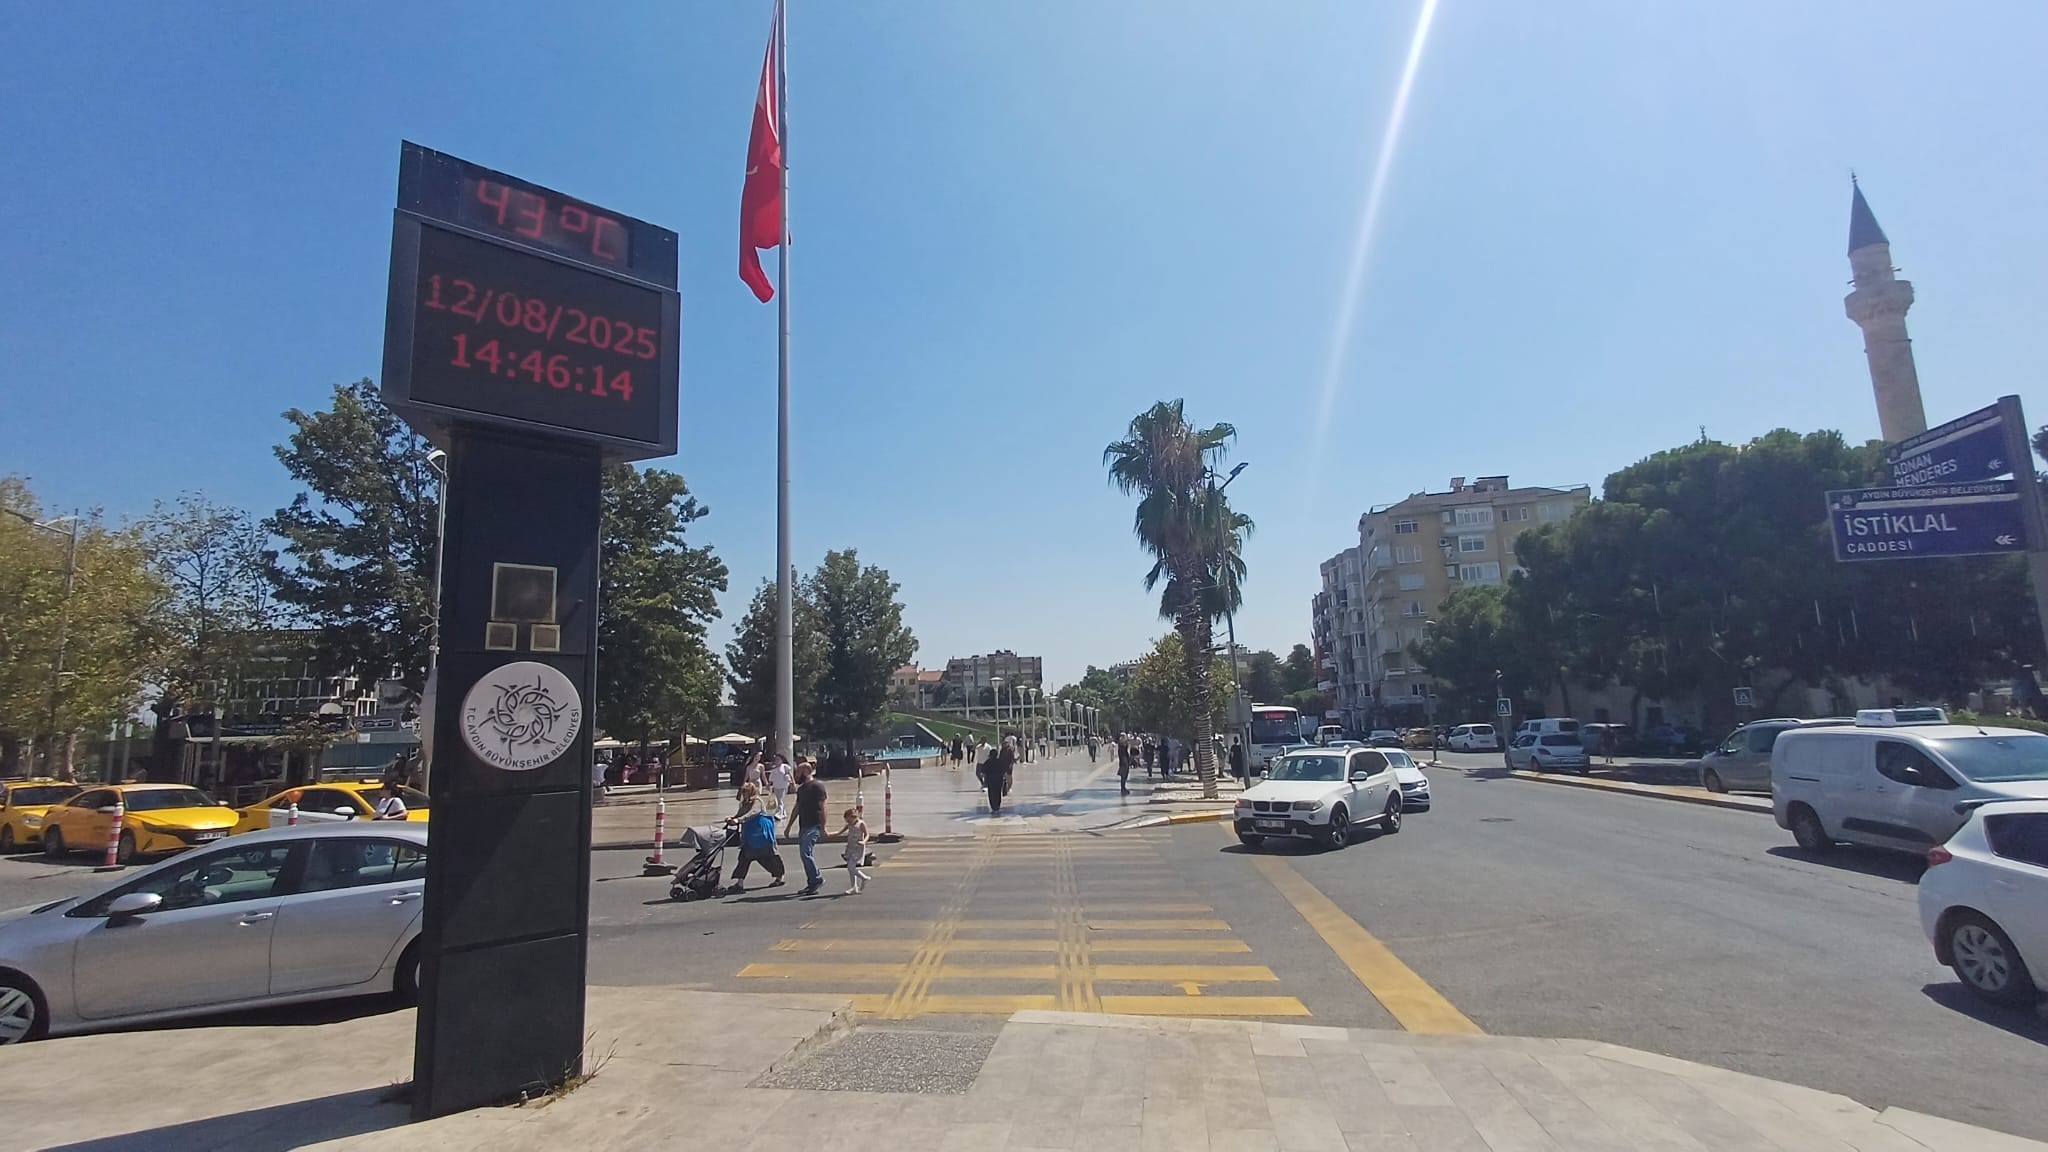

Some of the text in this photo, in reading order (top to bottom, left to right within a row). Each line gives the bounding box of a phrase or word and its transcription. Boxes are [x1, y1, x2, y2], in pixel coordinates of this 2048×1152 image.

[424, 274, 658, 360] 12/08/2025
[451, 332, 634, 401] 14:46:14
[1893, 453, 1932, 477] ADNAN
[1896, 459, 1958, 487] MENDERES
[1862, 490, 1890, 500] AYDIN
[1844, 513, 1957, 536] İSTİKLAL
[1847, 539, 1913, 553] CADDESİ
[485, 749, 550, 768] BÜYÜKŞEHİR
